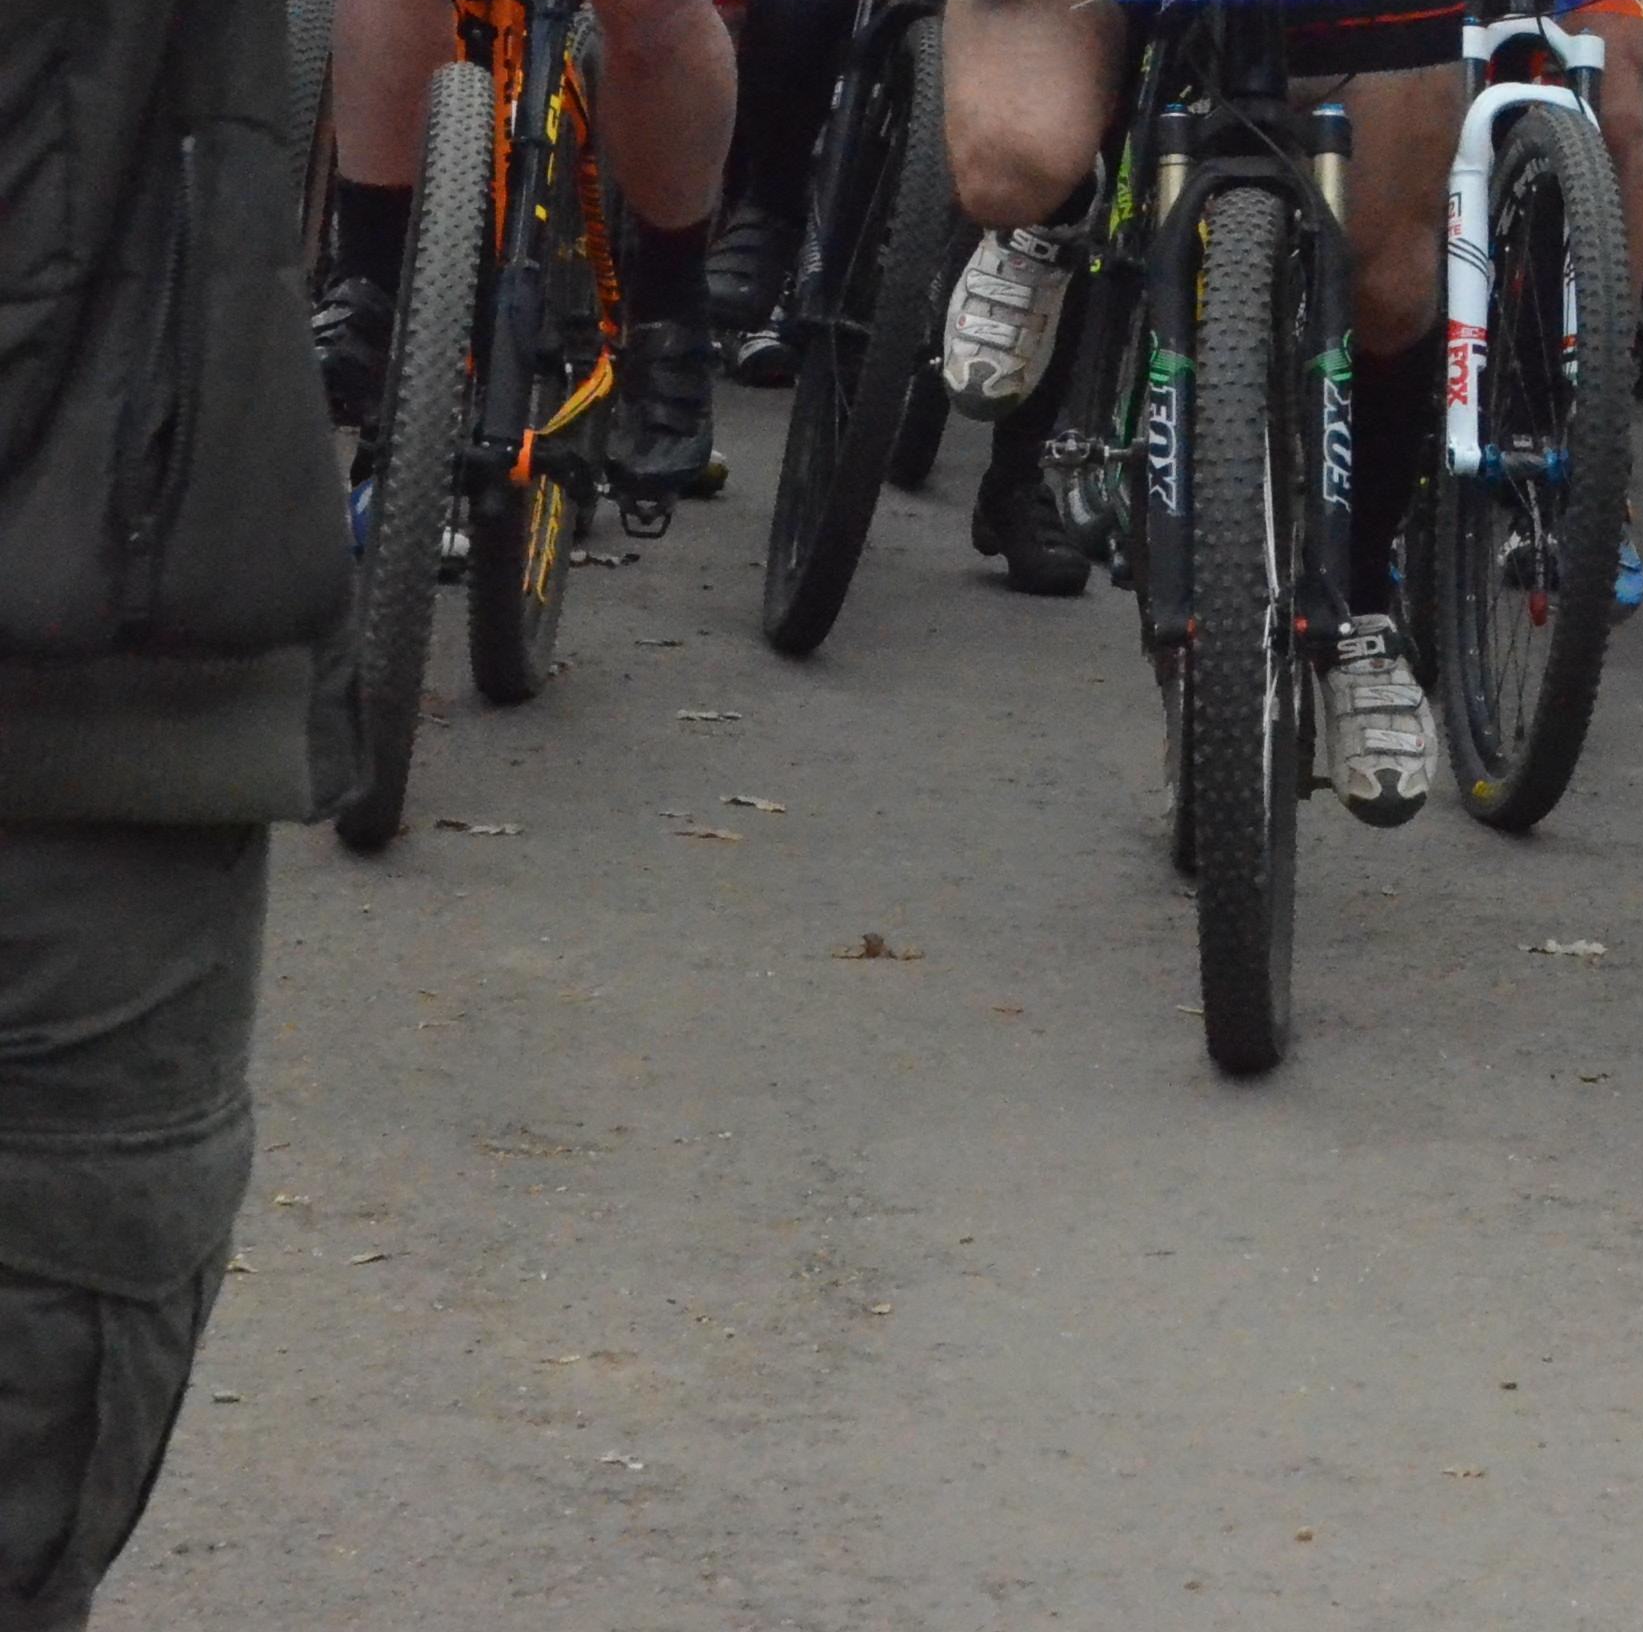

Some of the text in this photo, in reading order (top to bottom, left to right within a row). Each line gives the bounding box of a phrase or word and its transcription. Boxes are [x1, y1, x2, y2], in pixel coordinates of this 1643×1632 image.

[1447, 342, 1471, 406] FOX
[1149, 381, 1179, 513] FOX
[1321, 378, 1354, 510] FOX
